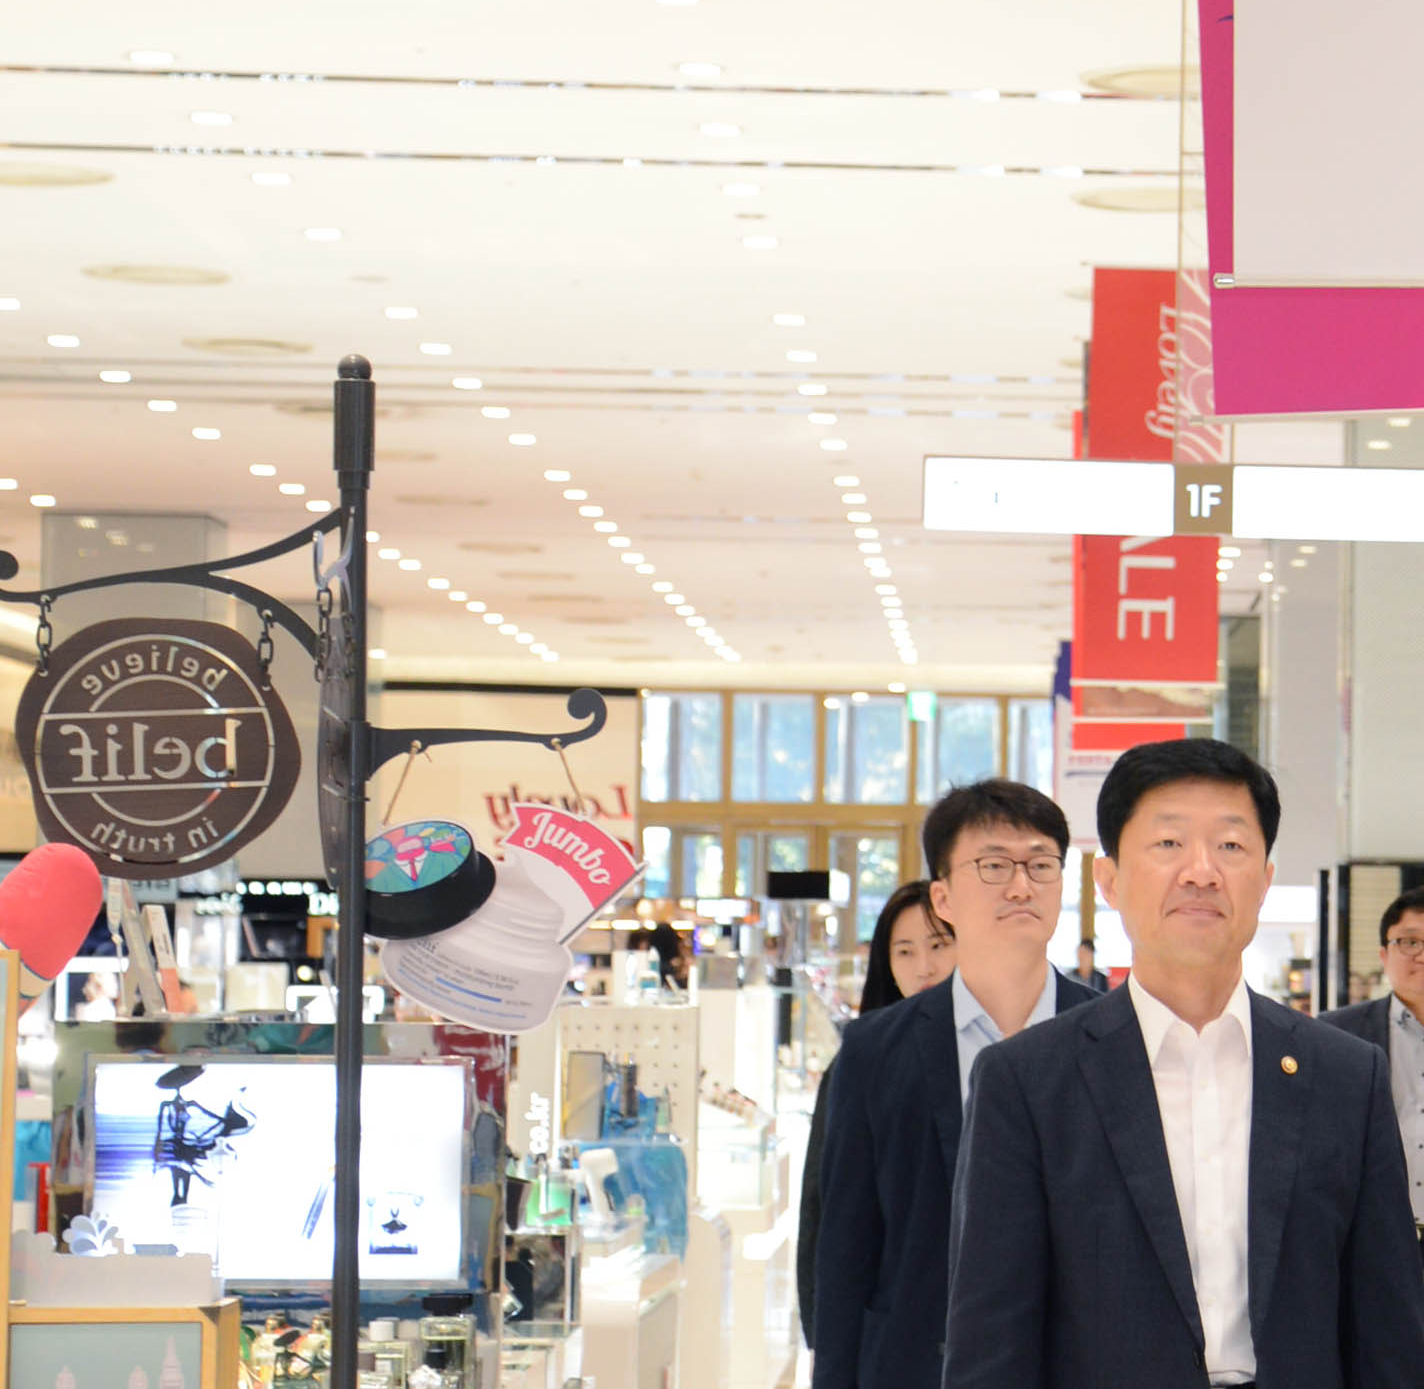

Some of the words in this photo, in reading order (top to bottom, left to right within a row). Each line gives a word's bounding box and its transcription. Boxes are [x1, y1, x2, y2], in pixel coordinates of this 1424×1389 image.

[1145, 303, 1180, 439] Lovely
[1185, 483, 1223, 518] 1F
[523, 811, 612, 886] Jumbo
